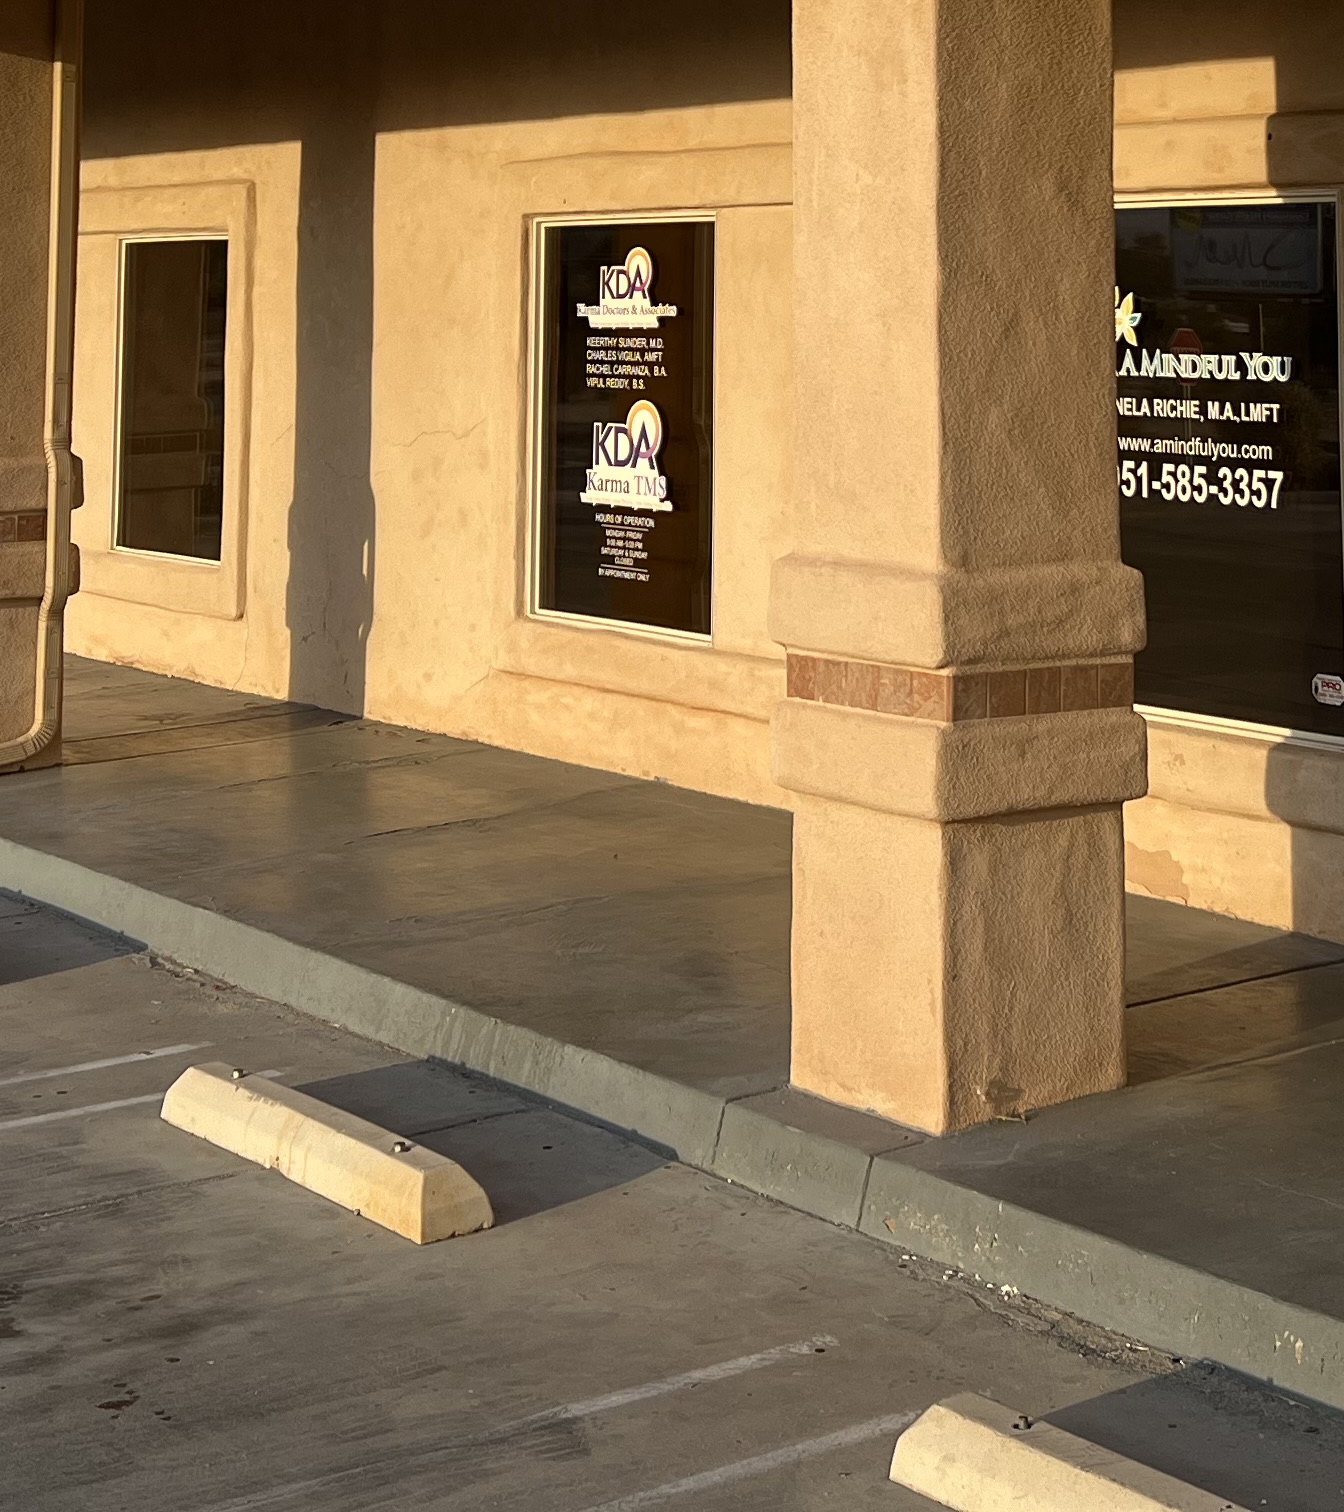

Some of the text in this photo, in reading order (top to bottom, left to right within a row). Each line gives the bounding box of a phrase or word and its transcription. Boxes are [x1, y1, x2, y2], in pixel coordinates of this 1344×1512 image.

[602, 264, 648, 300] KDA
[602, 304, 629, 316] Doctors
[631, 304, 638, 315] &
[639, 304, 676, 316] Associates
[586, 349, 616, 361] CHARLES
[1118, 348, 1293, 382] A MINDFUL YOU
[586, 363, 612, 375] RACHEL
[1153, 398, 1205, 423] RICHIE,
[594, 420, 656, 471] KDA
[1117, 436, 1273, 462] www.amindfulyou.com
[587, 471, 667, 499] Karma TMS
[1116, 460, 1284, 509] 51-585-3357
[595, 512, 614, 524] HOURS
